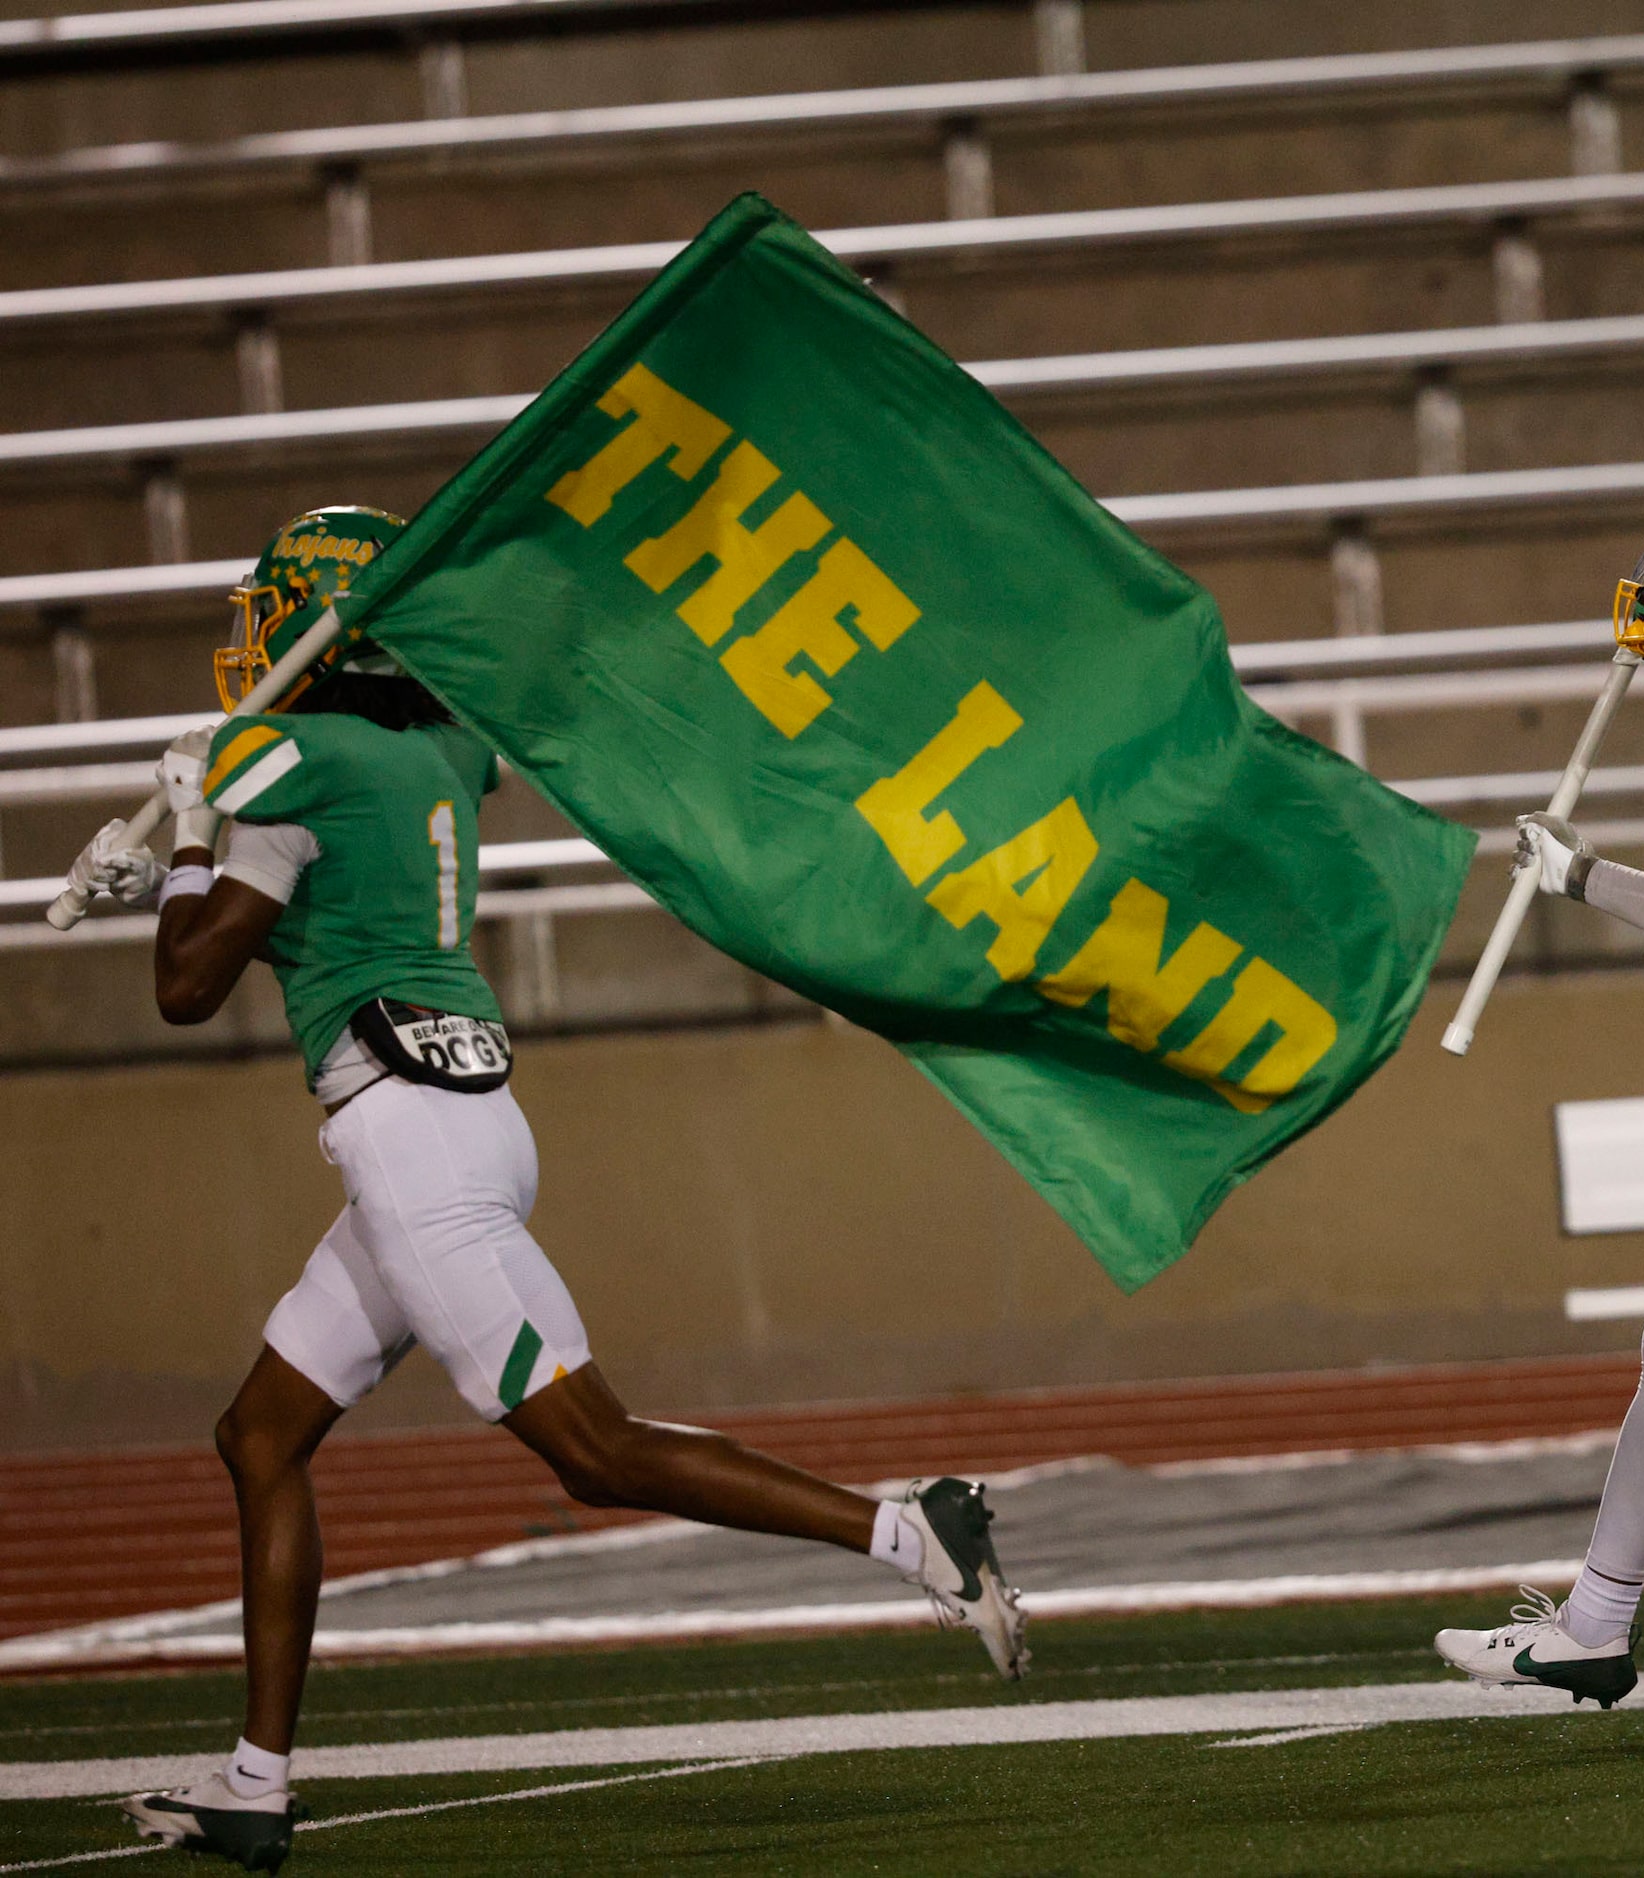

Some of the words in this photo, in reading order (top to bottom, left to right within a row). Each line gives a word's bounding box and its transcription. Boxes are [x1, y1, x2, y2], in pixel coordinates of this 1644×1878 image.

[272, 525, 374, 567] Trojans
[545, 361, 922, 741] THE
[853, 678, 1338, 1114] LAND
[427, 800, 460, 949] 1
